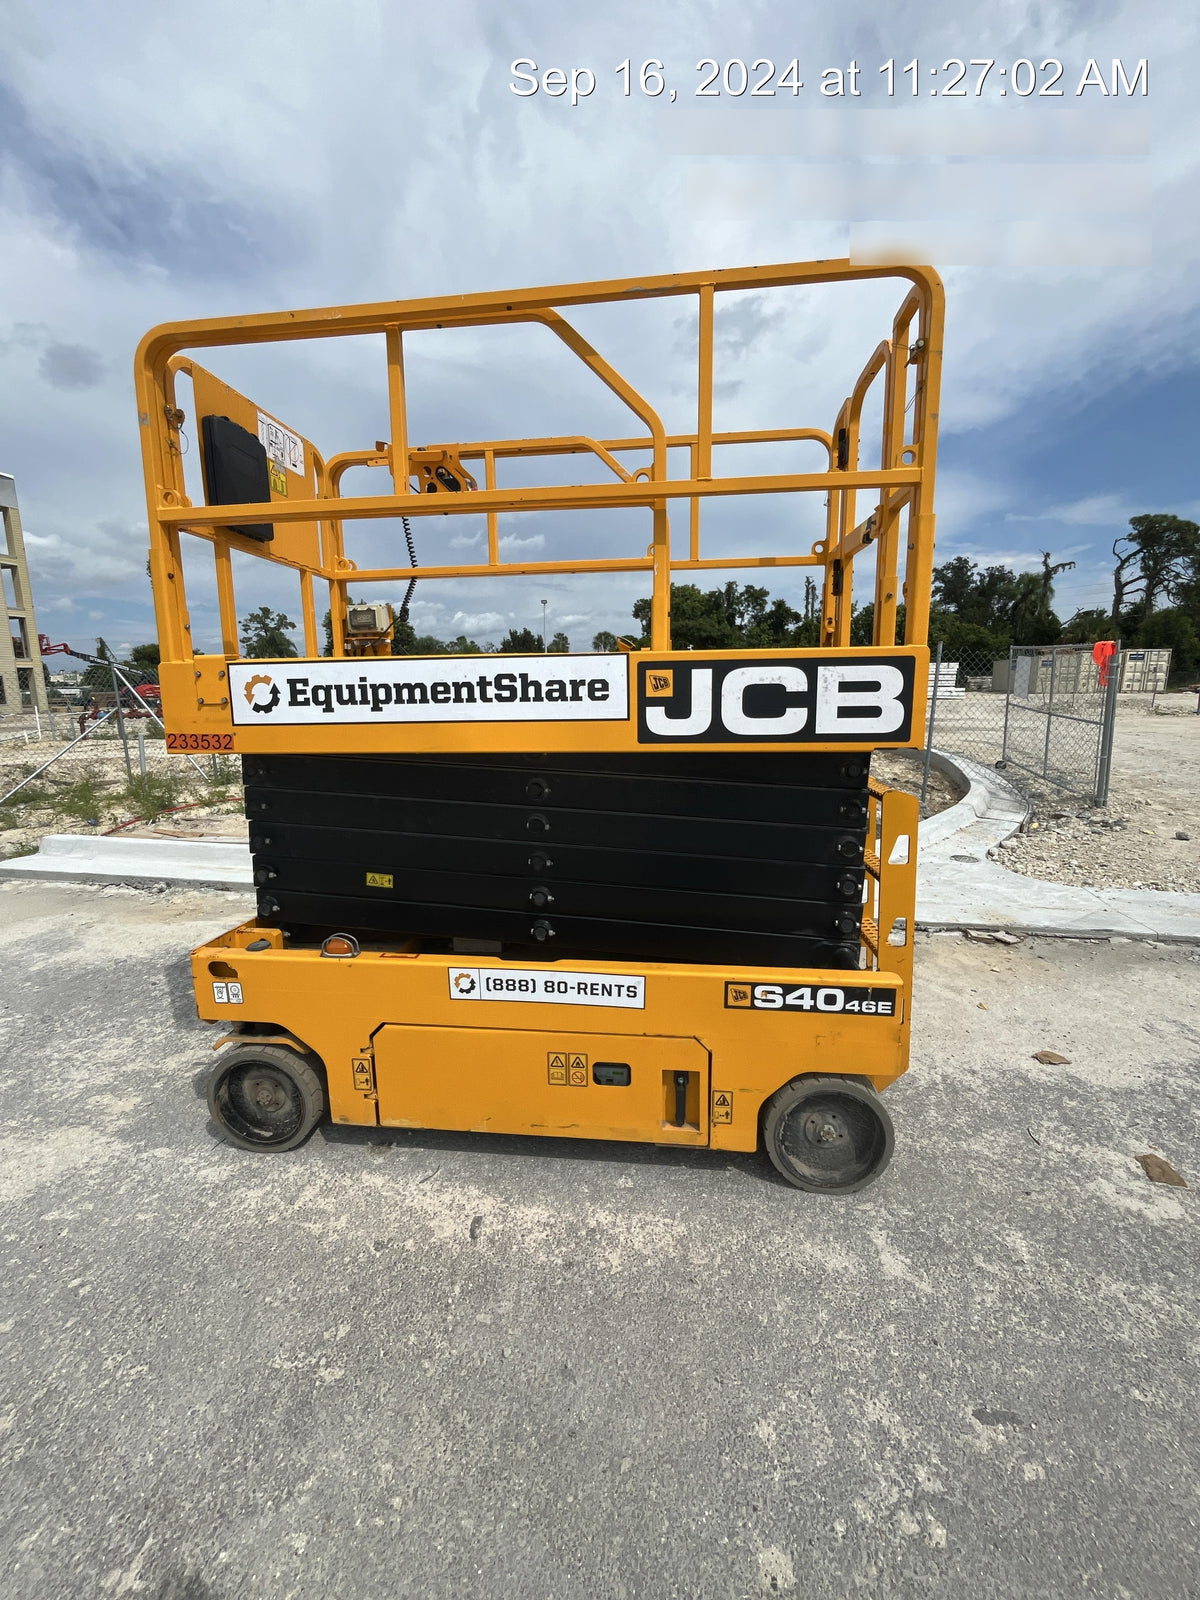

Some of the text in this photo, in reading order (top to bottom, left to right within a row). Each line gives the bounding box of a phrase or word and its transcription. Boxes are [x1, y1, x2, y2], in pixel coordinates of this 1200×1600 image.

[286, 672, 610, 713] EquipmentShare
[645, 664, 905, 736] JCB
[167, 733, 233, 749] 233532
[486, 976, 638, 998] (888) 80-RENTS
